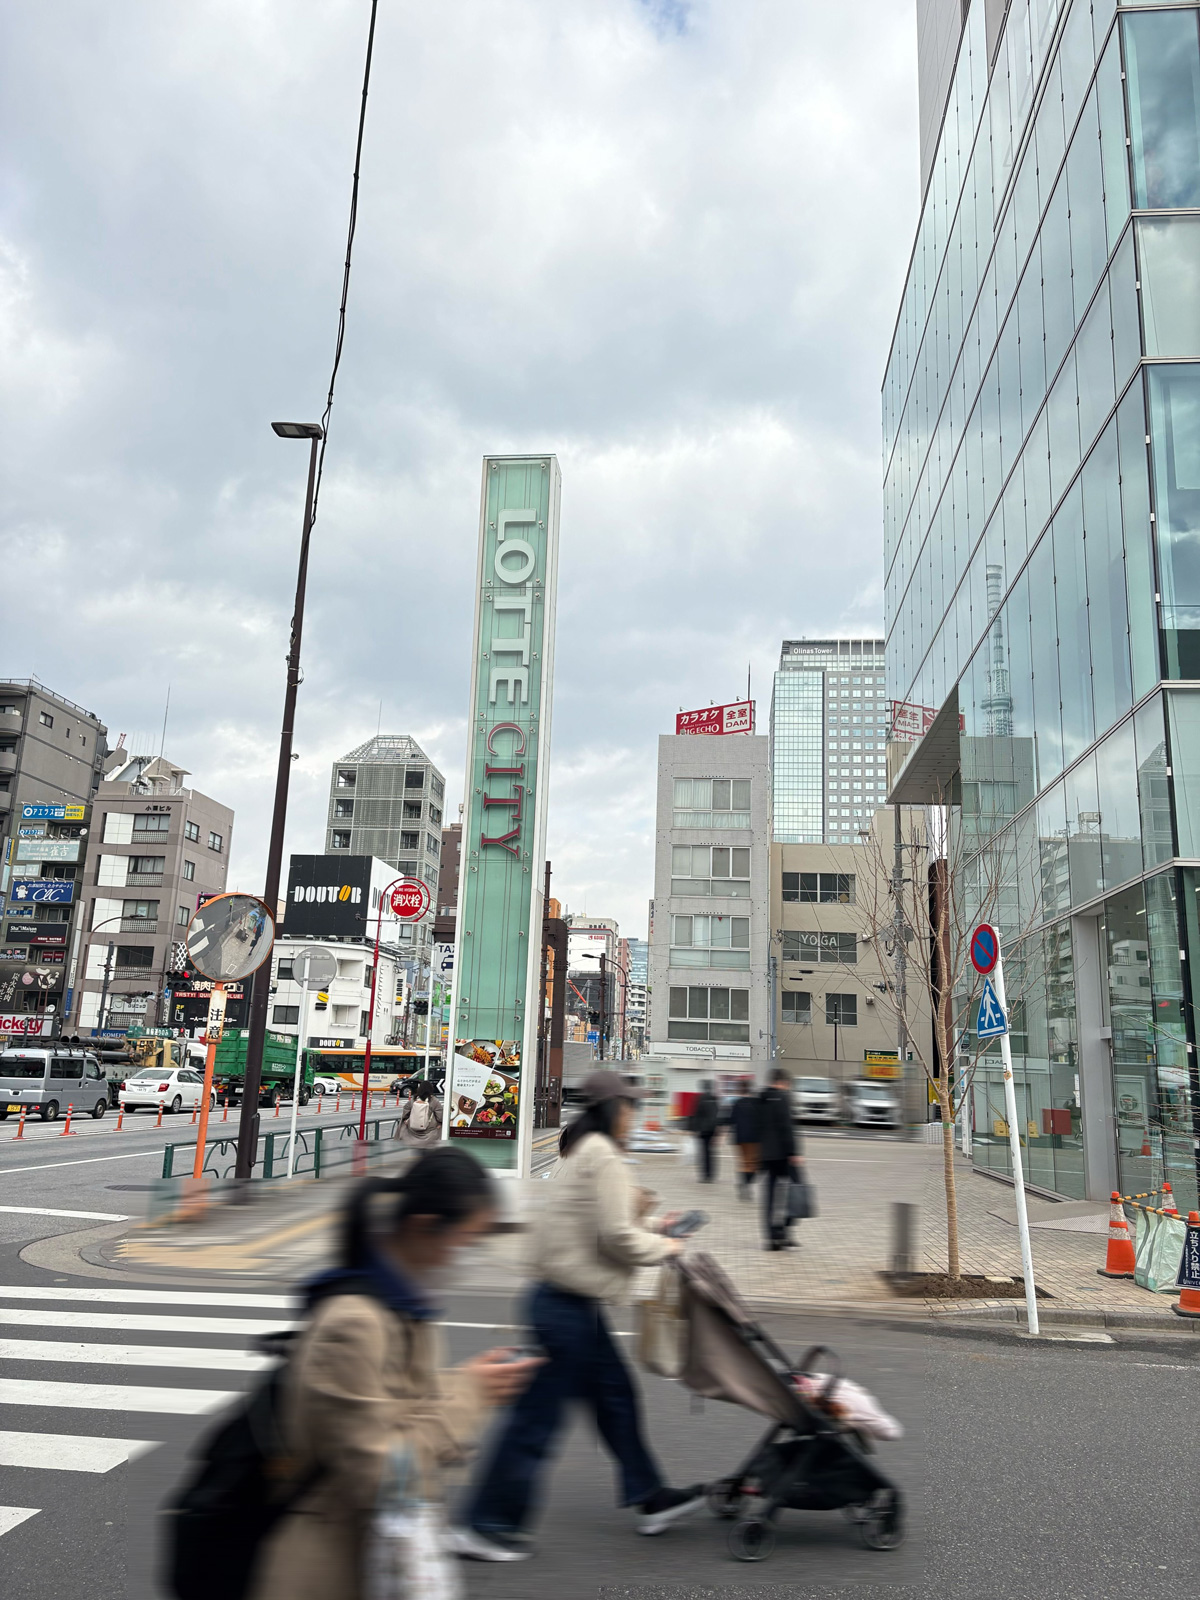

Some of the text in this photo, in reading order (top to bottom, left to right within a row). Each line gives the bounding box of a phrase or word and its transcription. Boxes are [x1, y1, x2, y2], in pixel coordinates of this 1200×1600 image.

[793, 647, 814, 655] Olinas
[480, 508, 537, 860] LOTTE CITY
[680, 709, 720, 725] カラオケ
[726, 708, 748, 720] 全室
[696, 723, 720, 734] ECHO
[725, 719, 748, 729] DAM
[32, 808, 54, 816] アエラス
[293, 884, 362, 904] DOUTOR
[393, 893, 421, 908] 消火栓
[801, 935, 837, 946] YOGA
[395, 978, 404, 1006] DOUTOR
[209, 1008, 223, 1040] 注意
[319, 1038, 344, 1048] DOUTOR
[1189, 1230, 1200, 1279] 立ち入り禁止
